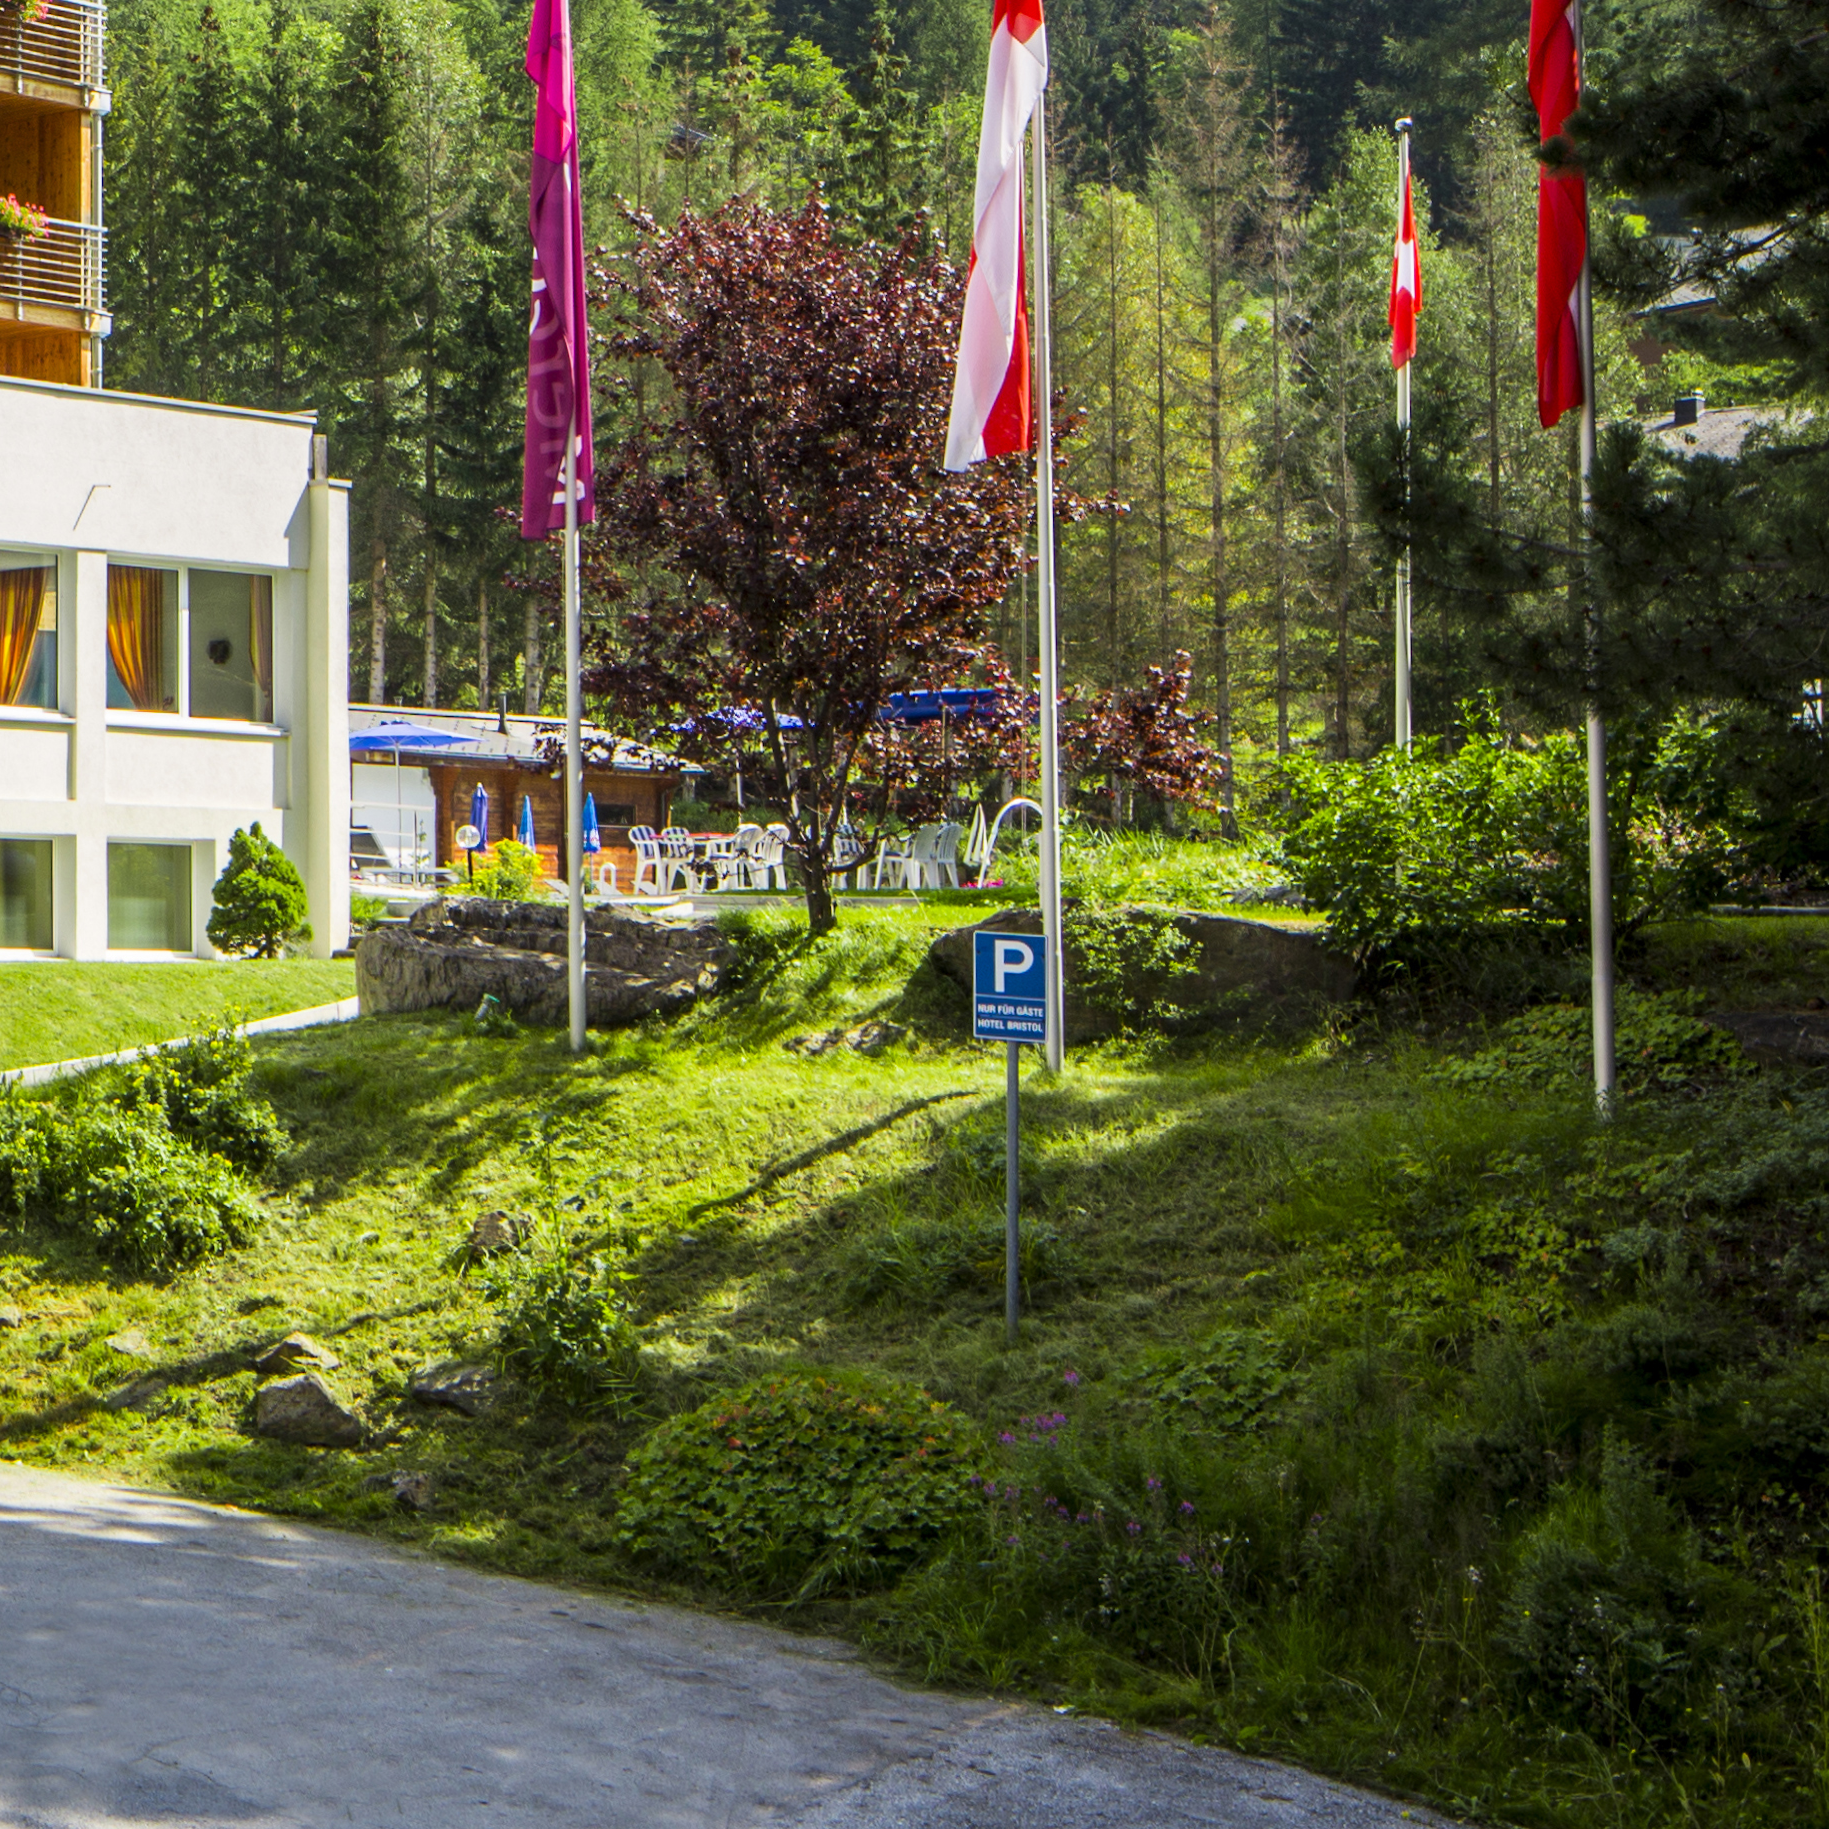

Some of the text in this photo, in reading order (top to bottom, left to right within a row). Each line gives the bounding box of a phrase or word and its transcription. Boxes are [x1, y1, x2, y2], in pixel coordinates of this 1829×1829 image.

[994, 939, 1034, 993] P
[978, 1003, 1043, 1017] NUR FÜR GÄSTE
[978, 1019, 1043, 1032] HOTEL BRISTOL
